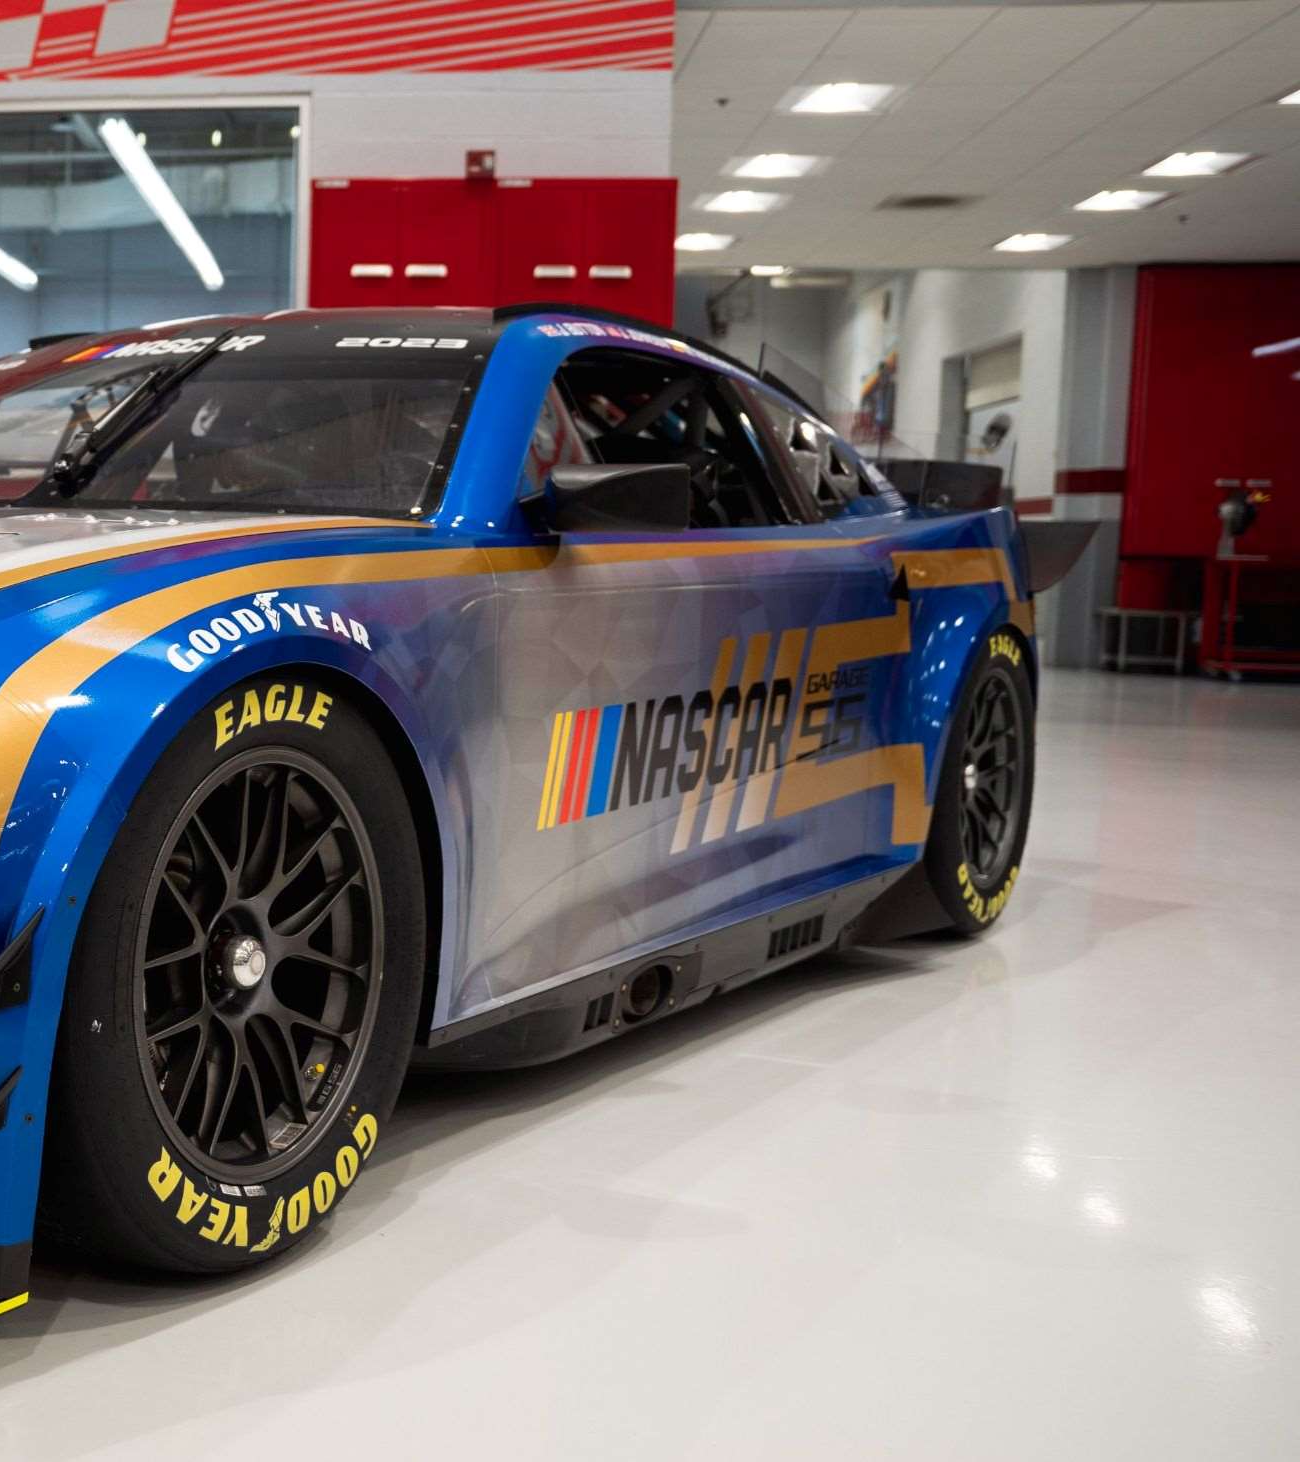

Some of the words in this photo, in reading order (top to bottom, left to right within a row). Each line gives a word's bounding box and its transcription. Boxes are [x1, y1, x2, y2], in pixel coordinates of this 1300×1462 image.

[335, 337, 469, 349] 2023
[990, 634, 1021, 667] EAGLE
[806, 667, 869, 695] GARAGE
[214, 683, 333, 751] EAGLE
[796, 693, 867, 762] 56
[608, 677, 792, 813] NASCAR
